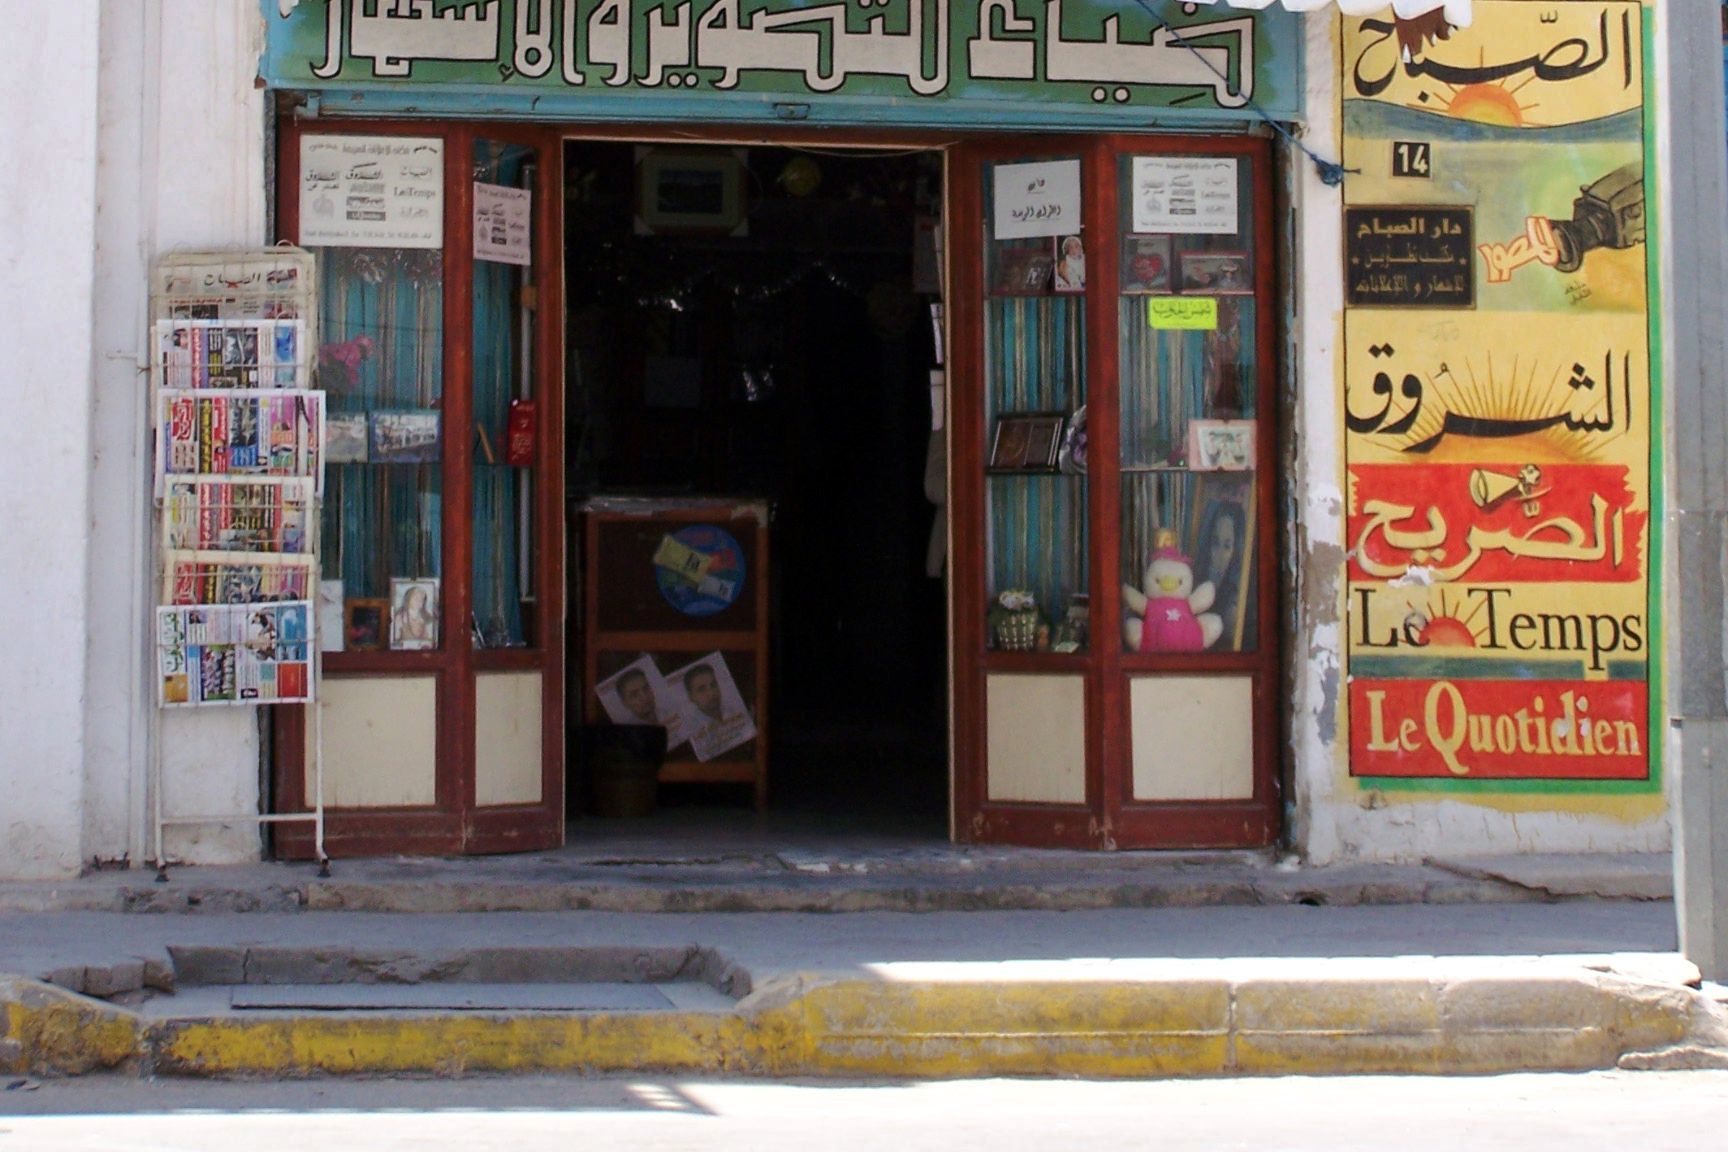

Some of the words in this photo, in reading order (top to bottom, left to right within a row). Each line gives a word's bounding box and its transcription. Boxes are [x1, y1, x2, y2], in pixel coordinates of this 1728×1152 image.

[1398, 144, 1429, 174] 14
[1354, 587, 1430, 648] Le
[1467, 587, 1642, 672] Temps
[1366, 690, 1422, 752] Le
[1424, 680, 1641, 774] Quotidien
